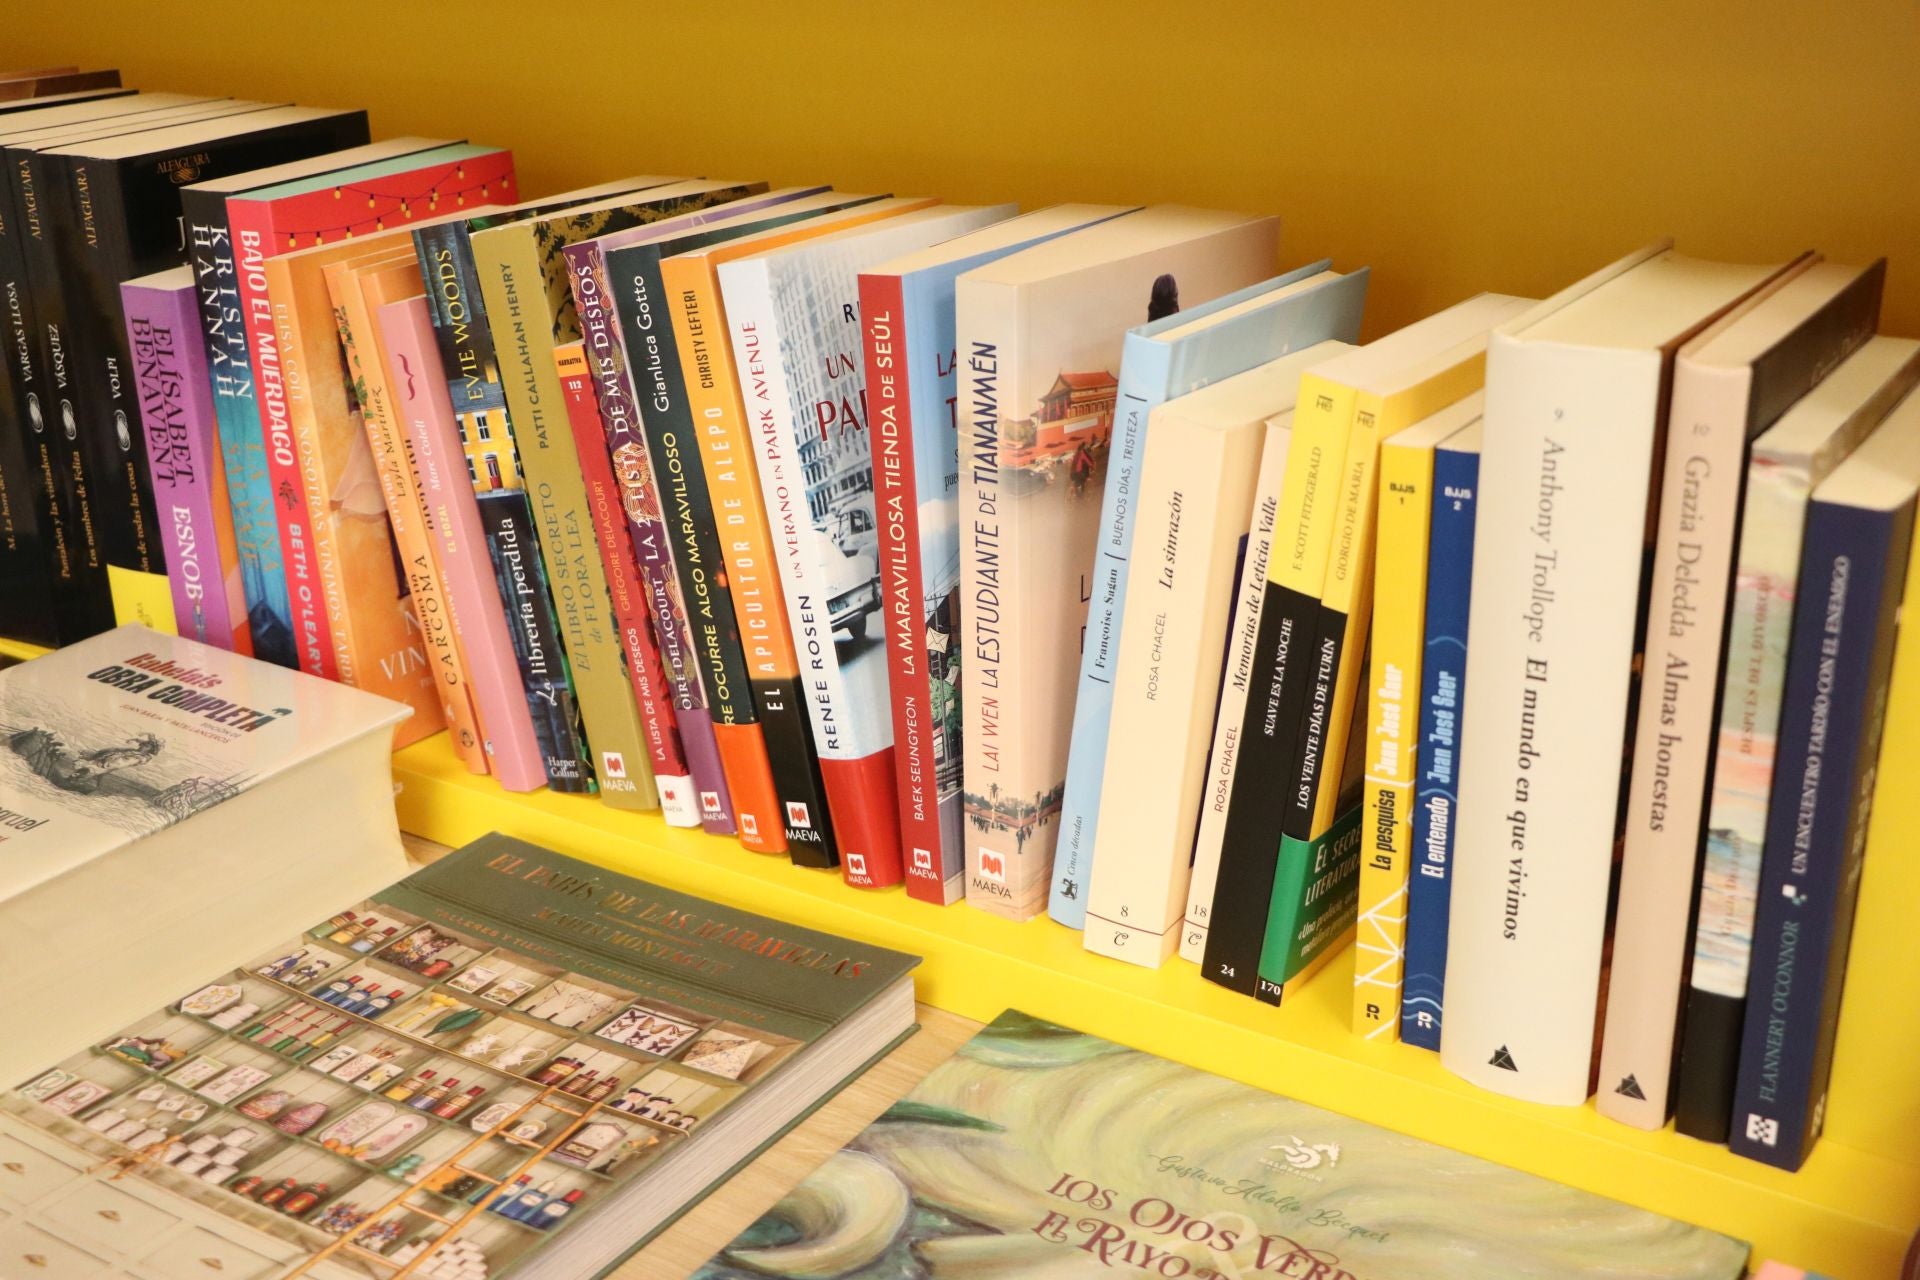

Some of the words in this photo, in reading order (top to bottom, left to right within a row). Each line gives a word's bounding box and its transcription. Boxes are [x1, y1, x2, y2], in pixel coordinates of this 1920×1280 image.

[19, 159, 42, 240] ALFAGUARA
[75, 167, 98, 248] ALFAGUARA
[240, 230, 267, 292] BAJO
[7, 281, 23, 326] LLOSA
[192, 223, 234, 398] HANNAH
[209, 225, 253, 399] KRISTIN
[251, 298, 272, 325] EL
[435, 249, 470, 345] WOODS
[500, 263, 521, 317] HENRY
[577, 265, 610, 350] DESEOS
[633, 275, 654, 331] Gotto
[682, 290, 704, 337] LEFTERI
[514, 321, 541, 405] CALLAHAN
[741, 321, 771, 402] AVENUE
[870, 311, 893, 369] SEÚL
[107, 356, 122, 400] VOLPI
[286, 360, 303, 400] COLL
[458, 349, 484, 401] EVIE
[569, 380, 583, 391] 112
[600, 356, 622, 397] MIS
[645, 334, 672, 413] Gianluca
[694, 340, 714, 389] CHRISTY
[881, 374, 896, 399] DE
[131, 316, 177, 489] BENAVENT
[152, 326, 195, 484] ELÍSABET
[256, 331, 294, 466] MUÉRDAGO
[611, 404, 630, 434] DE
[968, 341, 999, 485] TIANANMÉN
[532, 408, 549, 449] PATTI
[704, 407, 737, 481] ALEPO
[761, 408, 782, 460] PARK
[879, 404, 902, 490] TIENDA
[76, 483, 86, 498] de
[126, 461, 137, 490] cosas
[299, 425, 327, 531] NOSOTRAS
[388, 459, 407, 498] Layla
[619, 441, 646, 500] LISTA
[774, 464, 785, 480] EN
[1112, 497, 1128, 546] BUENOS
[1123, 410, 1140, 462] TRISTEZA
[1301, 445, 1323, 520] FITZGERALD
[1444, 486, 1473, 499] BJJS
[1530, 436, 1566, 543] Anthony
[1678, 454, 1713, 534] Grazia
[129, 492, 139, 507] las
[592, 481, 616, 548] DELACOURT
[662, 432, 700, 563] MARAVILLOSO
[724, 498, 745, 525] DE
[776, 485, 800, 557] VERANO
[978, 490, 997, 515] DE
[1258, 496, 1278, 533] Valle
[1335, 525, 1354, 581] GIORGIO
[1348, 461, 1366, 503] MARIA
[81, 500, 94, 546] nombres
[133, 509, 144, 539] todas
[539, 483, 570, 582] SECRETO
[641, 533, 660, 561] LA
[1163, 490, 1184, 564] sinrazón
[1294, 519, 1310, 562] SCOTT
[89, 549, 98, 568] Los
[172, 504, 204, 600] ESNOB
[288, 523, 308, 579] BETH
[499, 517, 535, 594] perdida
[792, 562, 804, 579] UN
[887, 495, 914, 651] MARAVILLOSA
[1249, 538, 1270, 593] Leticia
[576, 565, 601, 631] FLORA
[692, 567, 714, 619] ALGO
[974, 521, 1001, 664] ESTUDIANTE
[1158, 566, 1174, 590] La
[1522, 550, 1558, 643] Trollope
[1668, 540, 1703, 638] Deledda
[414, 555, 458, 685] CARCOMA
[562, 583, 585, 647] LIBRO
[652, 578, 681, 668] DELACOURT
[733, 541, 776, 673] APICULTOR
[1094, 609, 1112, 669] Françoise
[1103, 568, 1119, 605] Sagan
[1245, 594, 1261, 615] de
[519, 601, 547, 673] librería
[627, 627, 646, 673] DESEOS
[798, 595, 824, 670] ROSEN
[1151, 611, 1167, 663] CHACEL
[1232, 617, 1257, 692] Memorias
[1277, 617, 1293, 665] NOCHE
[124, 652, 222, 690] Rabelais
[705, 623, 731, 700] OCURRE
[903, 655, 916, 676] LA
[980, 668, 999, 690] LA
[1274, 665, 1285, 684] LA
[1318, 637, 1336, 681] TURÍN
[1378, 663, 1404, 701] Saer
[1525, 656, 1549, 682] El
[1815, 656, 1837, 694] CON
[87, 665, 164, 695] OBRA
[146, 684, 278, 733] COMPLETA
[535, 679, 558, 706] La
[639, 676, 650, 696] MIS
[645, 699, 655, 715] DE
[764, 688, 784, 712] EL
[1146, 666, 1160, 701] ROSA
[1271, 682, 1282, 700] ES
[1315, 681, 1329, 703] DE
[1431, 670, 1457, 708] Saer
[1660, 652, 1691, 727] Almas
[649, 717, 663, 745] LISTA
[815, 680, 840, 750] RENÉE
[981, 696, 1000, 736] WEN
[1264, 695, 1280, 737] SUAVE
[1308, 702, 1325, 735] DÍAS
[1376, 702, 1402, 738] José
[1429, 709, 1455, 747] José
[1517, 688, 1541, 770] mundo
[657, 747, 666, 760] LA
[905, 696, 922, 784] SEUNGYEON
[982, 744, 1000, 772] LAI
[1220, 725, 1238, 776] CHACEL
[1301, 735, 1320, 784] VEINTE
[1374, 741, 1400, 776] Juan
[602, 780, 637, 792] MAEVA
[1426, 748, 1453, 784] Juan
[1514, 776, 1530, 803] en
[1649, 731, 1684, 834] honestas
[704, 812, 728, 821] MAEVA
[912, 786, 924, 822] BAEK
[1214, 778, 1230, 813] ROSA
[1296, 784, 1311, 810] LOS
[785, 829, 822, 842] MAEVA
[1372, 789, 1400, 853] pesquisa
[1424, 797, 1450, 863] entenado
[1506, 810, 1528, 851] que
[848, 875, 873, 885] MAEVA
[908, 866, 939, 881] MAEVA
[1369, 851, 1392, 871] La
[1420, 861, 1445, 879] El
[972, 878, 1013, 900] MAEVA
[1503, 858, 1528, 941] vivimos
[485, 853, 525, 877] EL
[636, 901, 697, 930] LAS
[688, 919, 872, 979] MARAVILLAS
[1220, 964, 1236, 977] 24
[1260, 980, 1282, 996] 170
[1759, 1015, 1787, 1104] FLANNERY
[1046, 1172, 1119, 1211] LOS
[1129, 1196, 1240, 1252] OJOS
[1076, 1217, 1191, 1279] RAYO
